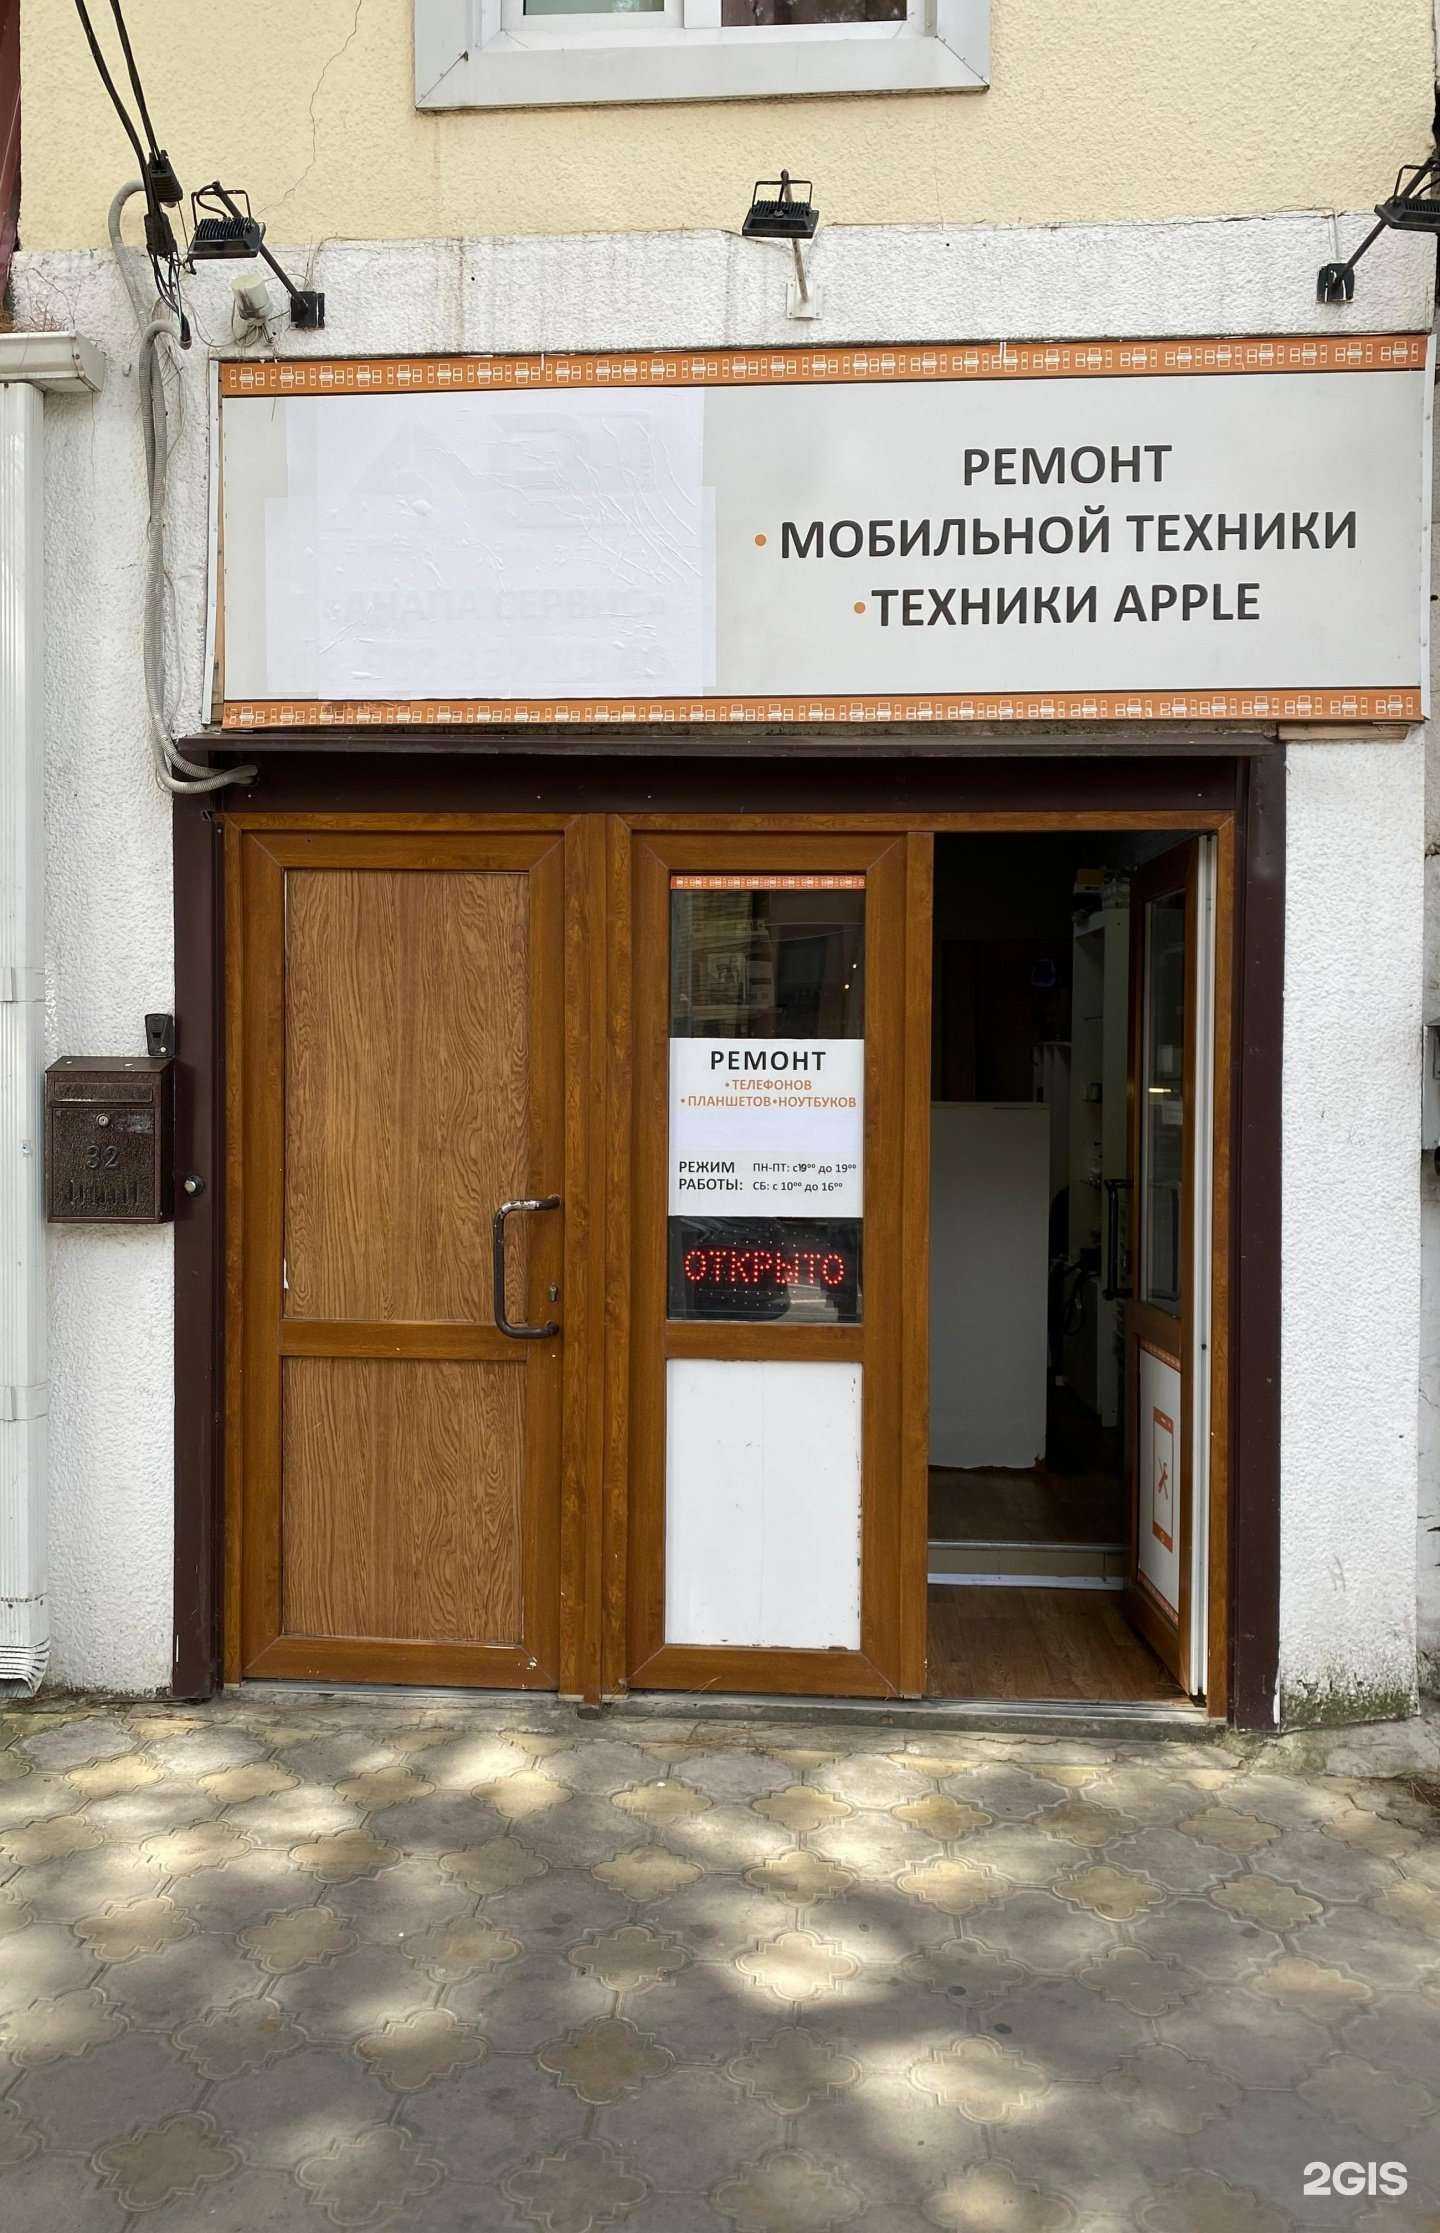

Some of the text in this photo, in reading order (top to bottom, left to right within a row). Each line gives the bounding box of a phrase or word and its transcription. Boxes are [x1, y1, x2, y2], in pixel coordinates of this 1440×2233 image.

[965, 445, 1172, 485] РЕМОНТ
[782, 505, 1355, 558] МОБИЛЬНОЙ ТЕХНИКИ
[872, 583, 1259, 626] ТЕХНИКИ APPLE
[711, 1051, 826, 1070] РЕМОНТ
[731, 1078, 813, 1091] ТЕЛЕФОНОВ
[687, 1095, 857, 1109] ПЛАНШЕТОВ НОУТБУКОВ
[87, 1145, 119, 1169] 32
[679, 1160, 735, 1174] РЕЖИМ
[752, 1162, 790, 1173] ПН-ПТ:
[817, 1165, 833, 1175] до
[678, 1178, 743, 1191] РАБОТЫ:
[752, 1181, 770, 1191] СБ:
[804, 1183, 819, 1193] до
[684, 1250, 846, 1285] ОТКРЫТО
